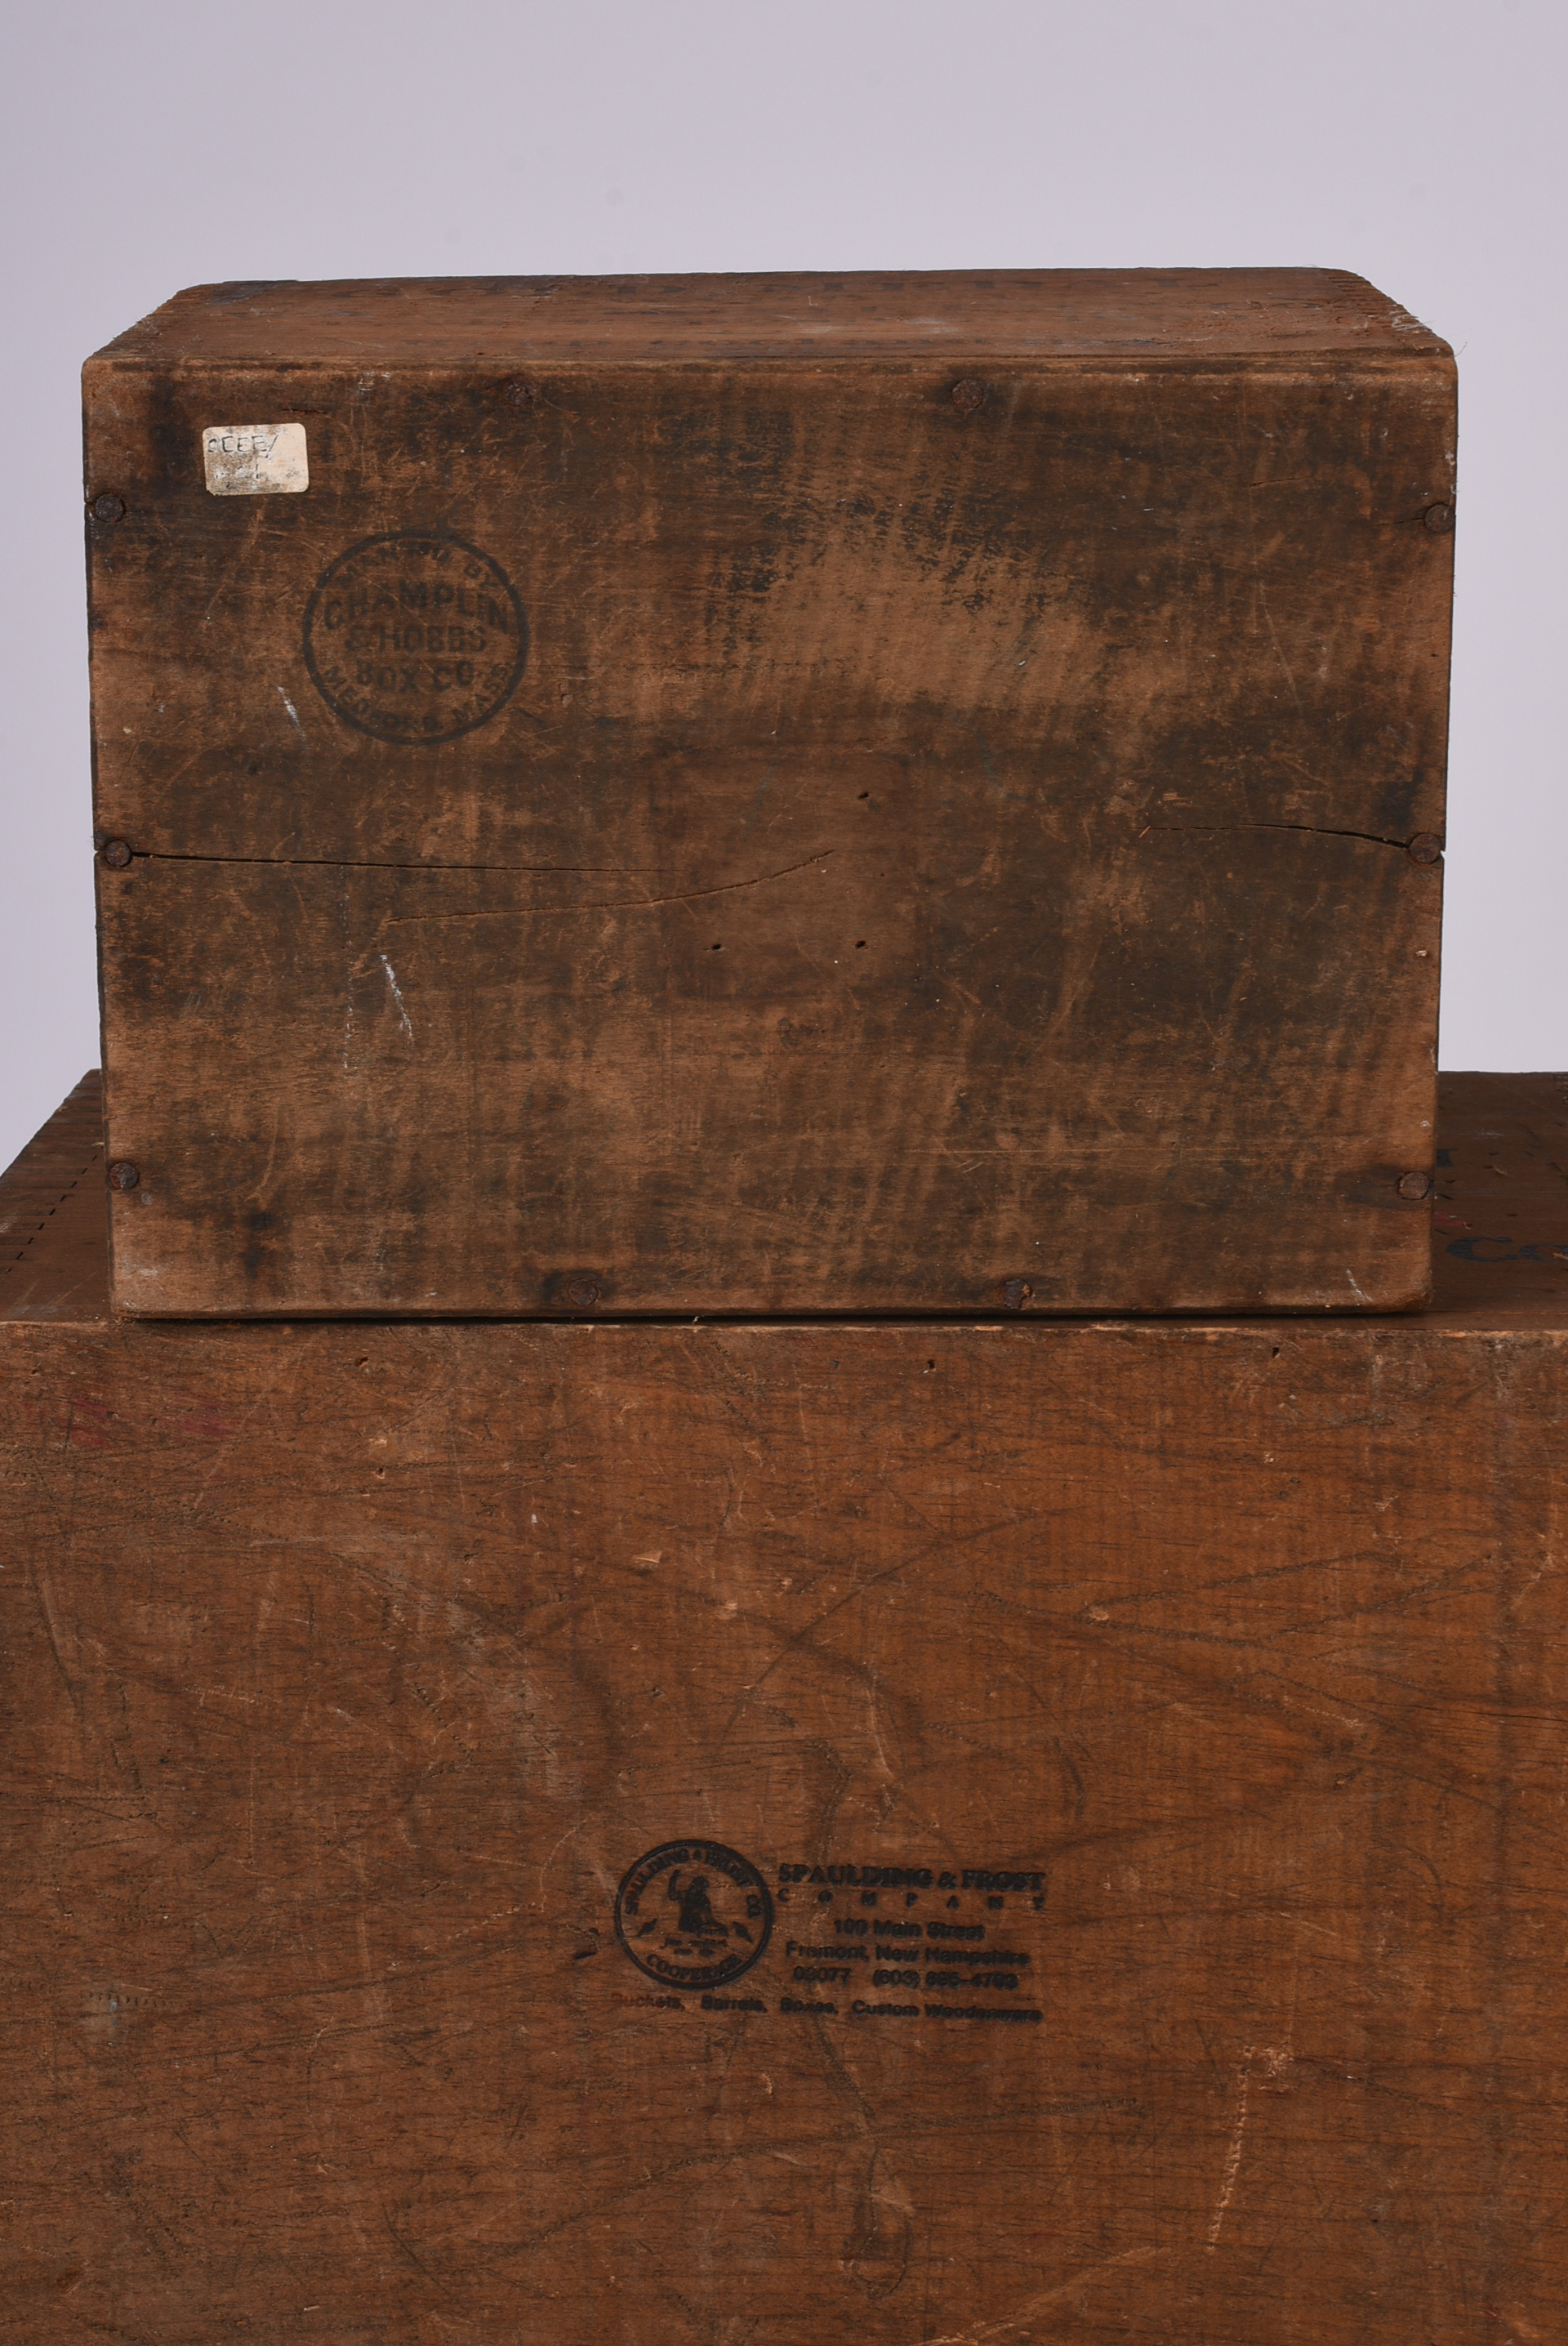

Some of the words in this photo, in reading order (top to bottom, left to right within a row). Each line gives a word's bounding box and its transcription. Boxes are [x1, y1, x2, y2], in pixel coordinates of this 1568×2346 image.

[323, 580, 509, 635] CHAMPLIN
[379, 625, 487, 653] HOBBS
[356, 659, 420, 694] BOX
[778, 1863, 935, 1889] SPAULDING
[938, 1871, 959, 1891] &
[962, 1870, 1046, 1893] FROST
[873, 1920, 923, 1938] Main
[927, 1922, 986, 1942] Street
[786, 1940, 870, 1963] Fremont,
[875, 1945, 920, 1963] New
[924, 1947, 1031, 1968] Hampshire
[852, 2000, 920, 2018] Custom
